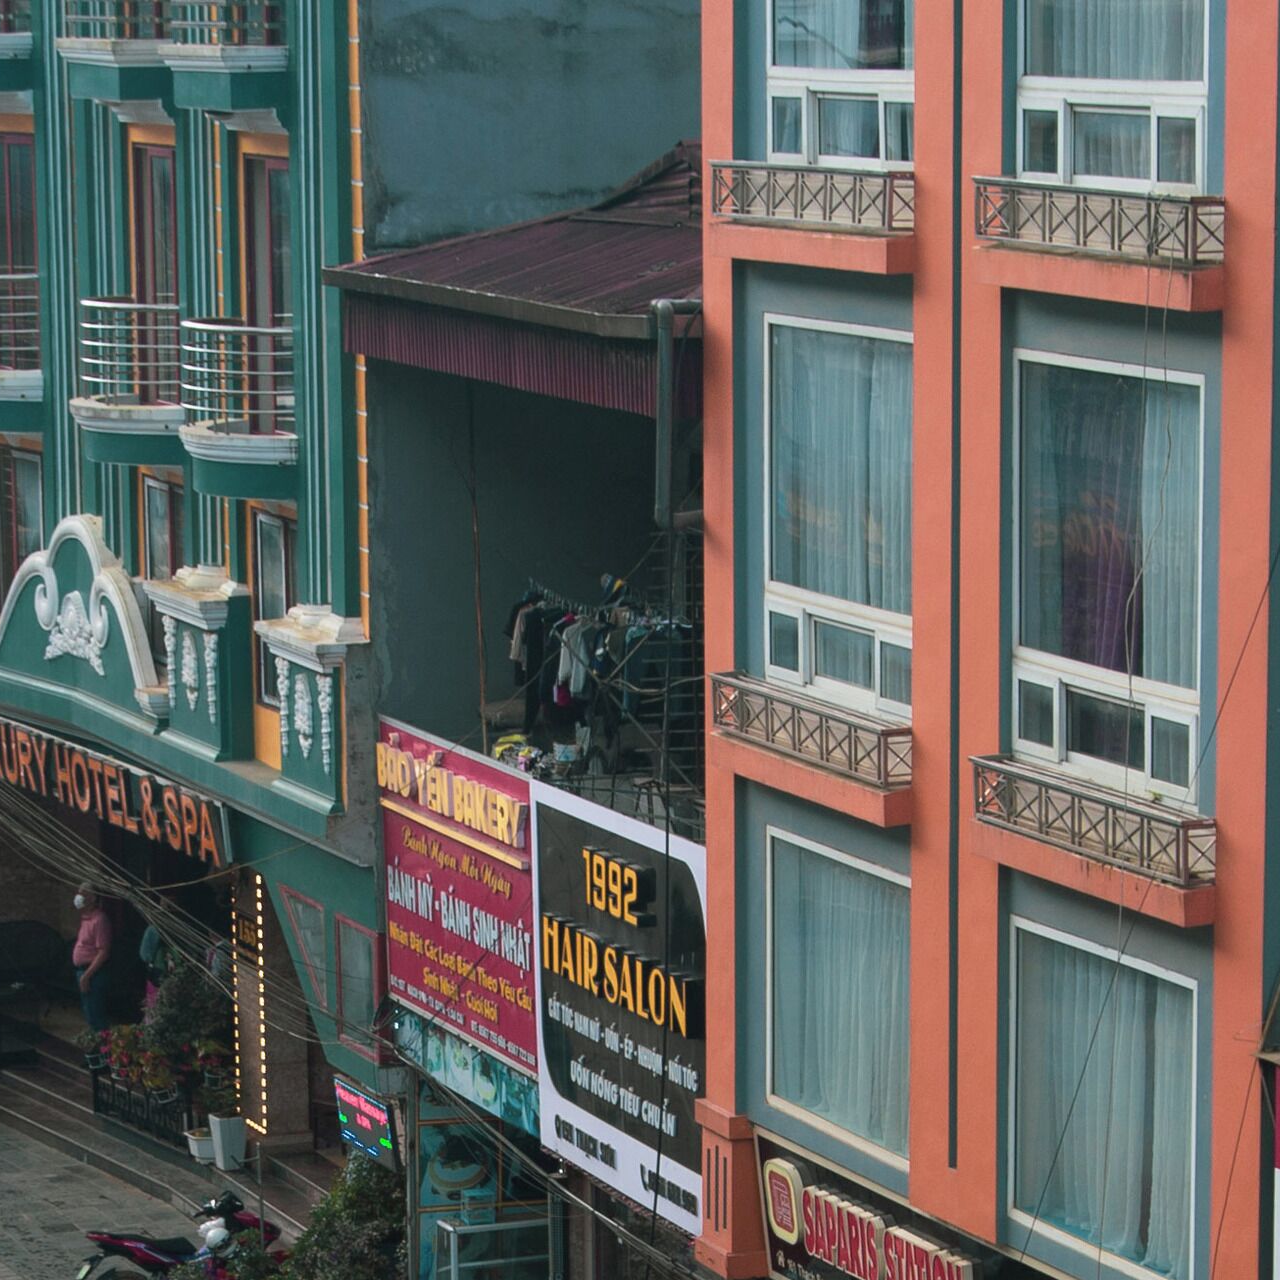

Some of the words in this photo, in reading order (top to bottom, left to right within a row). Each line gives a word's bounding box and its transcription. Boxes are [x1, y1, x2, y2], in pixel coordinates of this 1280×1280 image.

[54, 742, 139, 835] HOTEL
[139, 774, 161, 842] &
[162, 784, 220, 868] SPA
[453, 774, 526, 849] BAKERY
[387, 856, 416, 913] BÁNH
[441, 885, 470, 941] BÁNH
[473, 906, 499, 955] SINH
[501, 918, 531, 979] NHẬT
[583, 848, 638, 927] 1992
[543, 914, 598, 997] HAIR
[603, 946, 687, 1038] SALON
